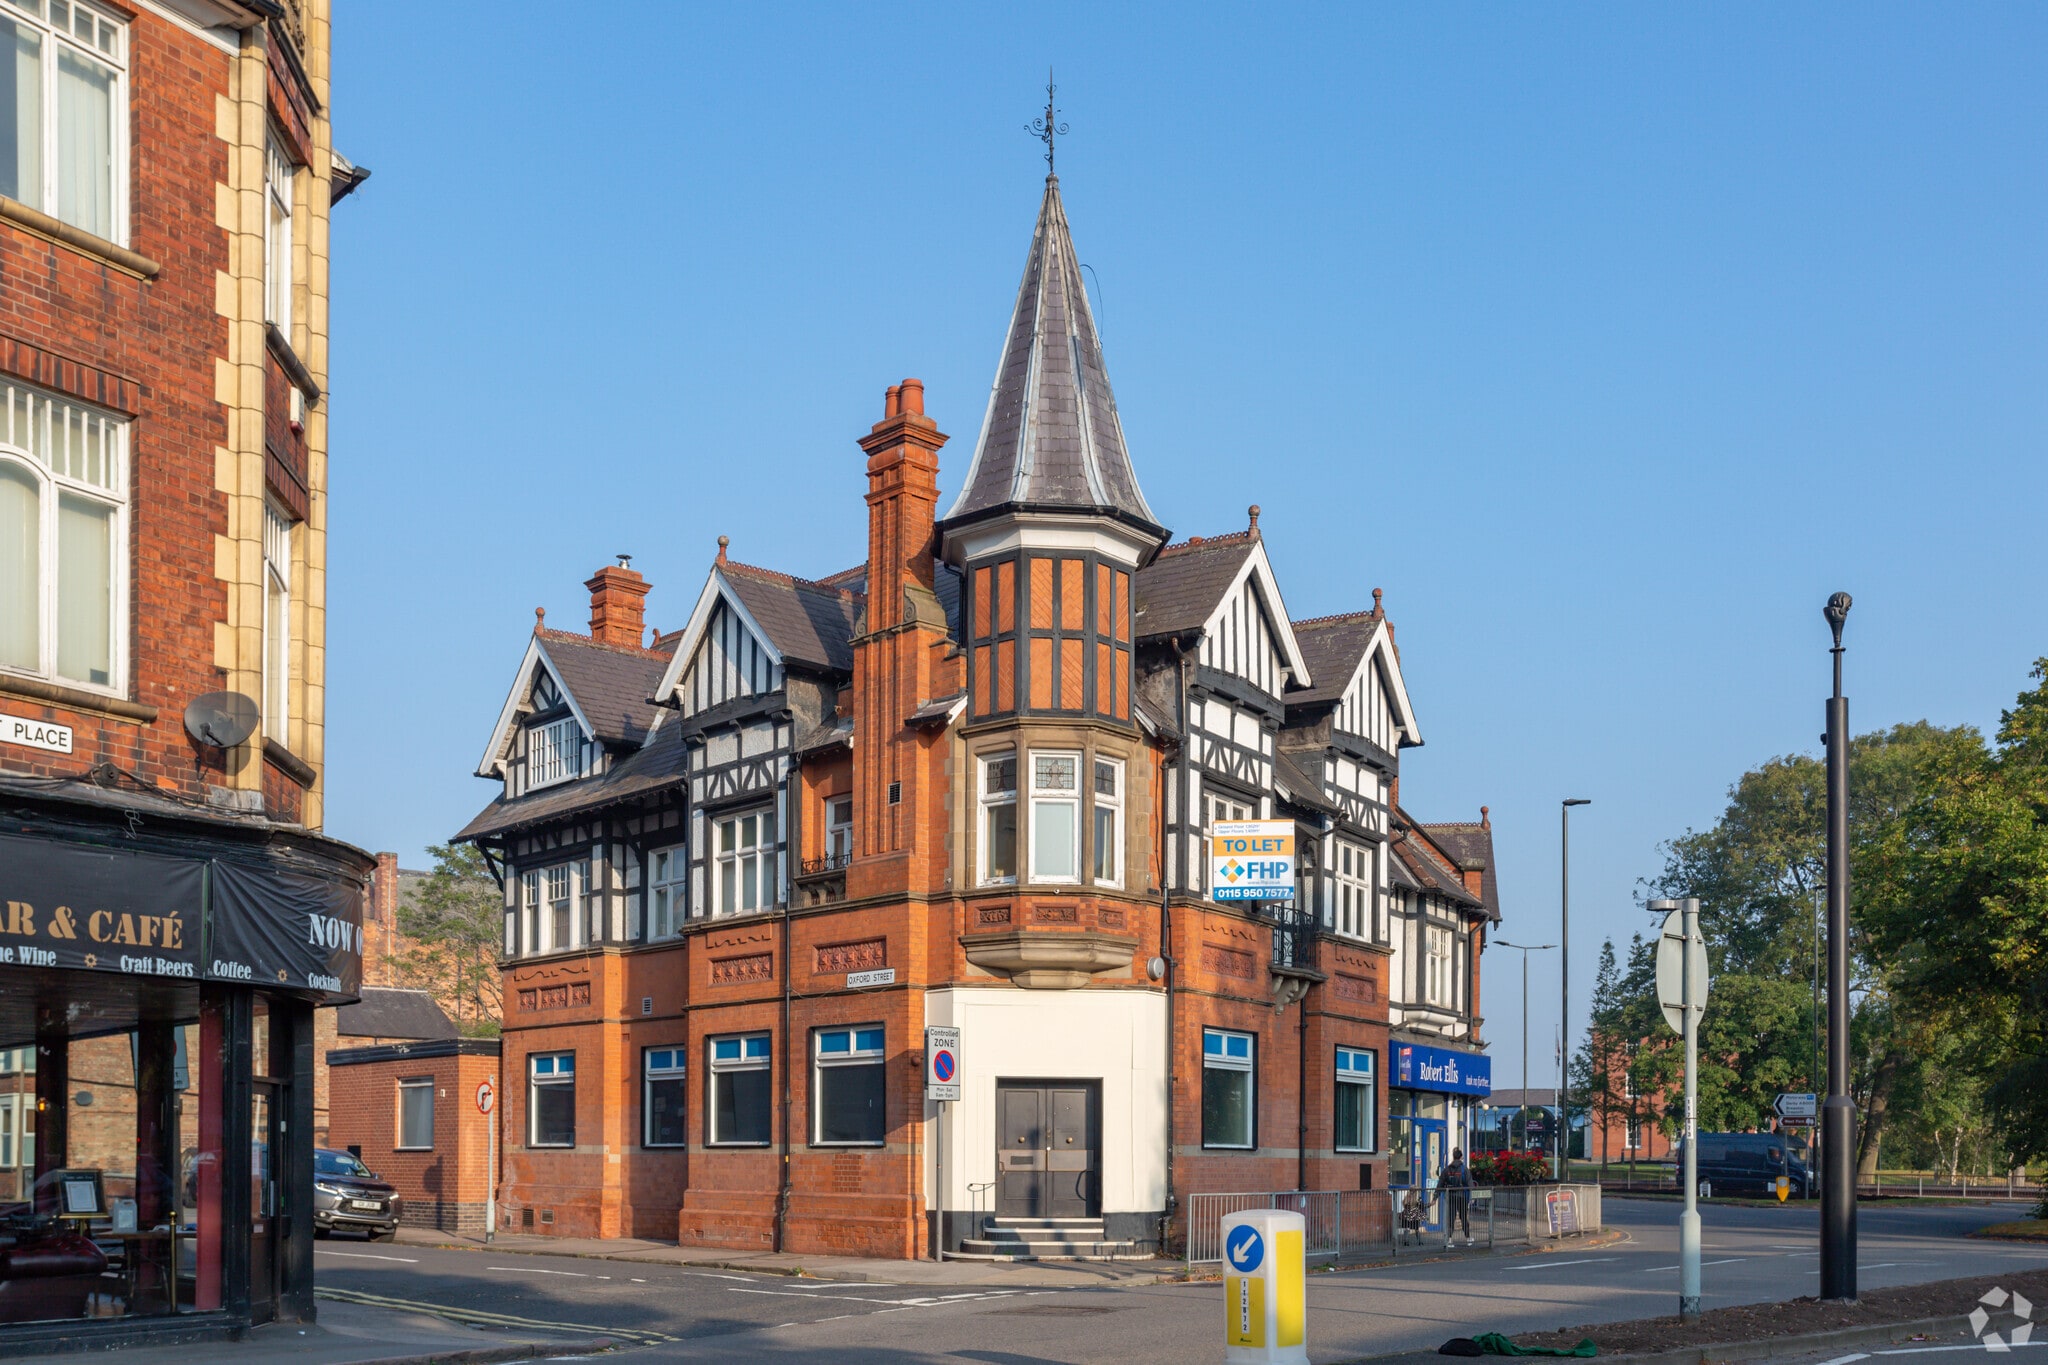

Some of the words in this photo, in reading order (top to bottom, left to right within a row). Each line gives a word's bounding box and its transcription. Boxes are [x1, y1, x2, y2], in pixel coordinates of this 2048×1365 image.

[15, 722, 67, 747] PLACE
[1223, 839, 1247, 853] TO
[1252, 839, 1284, 852] LET
[1247, 862, 1289, 879] FHP
[1218, 889, 1241, 898] 0115
[1243, 888, 1263, 898] 950
[1265, 888, 1289, 897] 7577
[0, 900, 37, 936] R
[48, 906, 77, 939] &
[88, 910, 183, 950] CAFÉ
[308, 913, 354, 953] NOW
[18, 945, 57, 967] Wine
[120, 954, 153, 974] Craft
[155, 957, 194, 977] Beers
[213, 959, 252, 980] Coffee
[848, 974, 870, 985] OXFORD
[873, 971, 893, 982] STREET
[308, 972, 342, 993] Cocktails
[930, 1028, 959, 1038] Controlled
[934, 1038, 955, 1048] ZONE
[1420, 1055, 1443, 1082] Robert
[1444, 1058, 1459, 1084] Ellis
